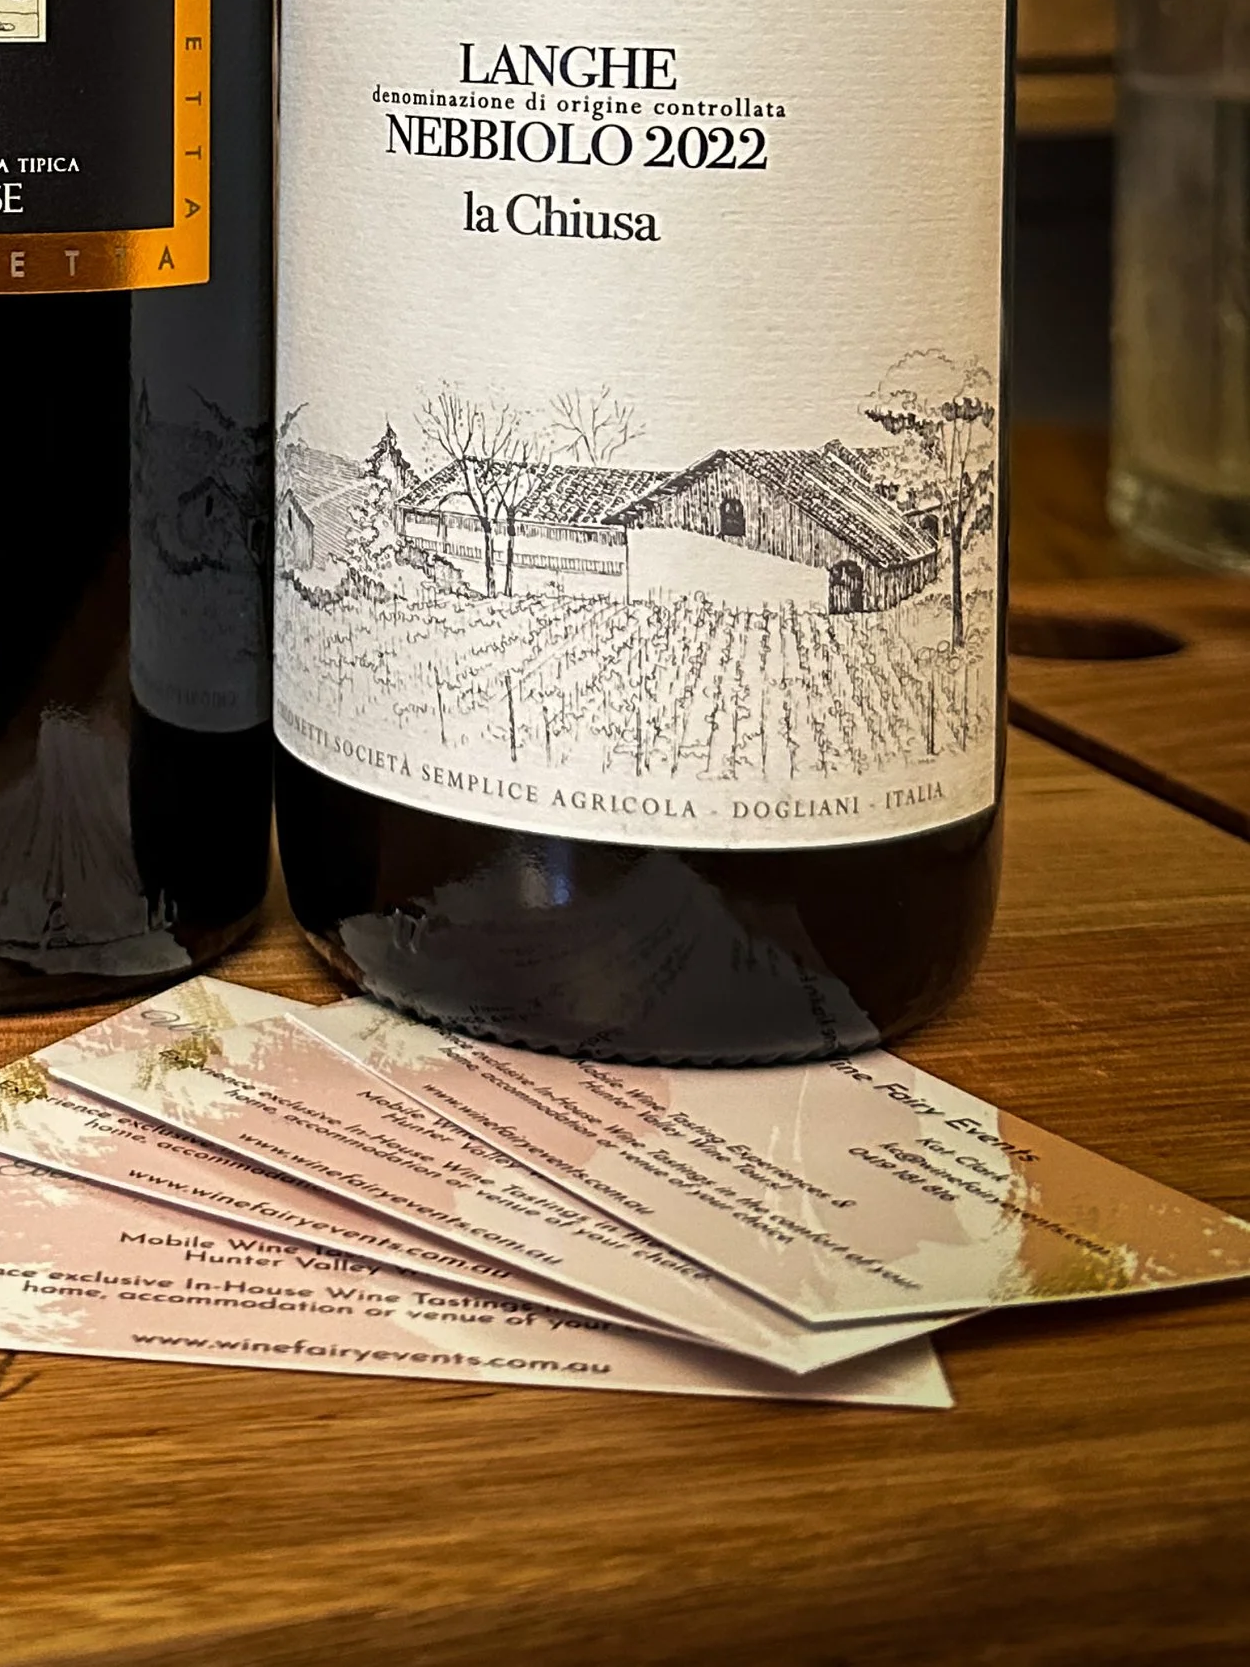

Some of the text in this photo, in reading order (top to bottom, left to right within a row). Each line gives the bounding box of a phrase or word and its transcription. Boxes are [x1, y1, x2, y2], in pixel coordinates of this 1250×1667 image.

[458, 42, 679, 92] LANGHE
[371, 85, 787, 121] denominazione di origine controllata
[17, 156, 80, 174] TIPICA
[385, 113, 770, 170] NEBBIOLO 2022
[463, 191, 661, 242] la Chiusa
[422, 763, 540, 804] SEMPLICE
[552, 793, 697, 819] AGRICOLA
[732, 797, 860, 820] DOGLIANI
[885, 780, 945, 810] ITALIA
[356, 1089, 426, 1121] Mobile
[381, 1111, 455, 1145] Hunter
[578, 1079, 636, 1111] Hunter
[636, 1109, 687, 1138] Valley
[688, 1136, 732, 1163] Wine
[828, 1055, 1041, 1164] ine Fairy Events
[83, 1117, 324, 1194] home, accommodat
[258, 1088, 343, 1126] exclusive
[344, 1123, 436, 1164] In-House
[442, 1160, 496, 1187] Wine
[499, 1183, 592, 1224] Tastings
[604, 1124, 647, 1149] Wine
[626, 1087, 667, 1112] Wine
[668, 1111, 727, 1146] Tasting
[726, 1143, 831, 1200] Experiences
[914, 1137, 1010, 1184] Kat Clark
[283, 1112, 443, 1180] accommodation
[445, 1176, 470, 1191] or
[476, 1188, 543, 1218] venue
[119, 1230, 216, 1251] Mobile
[227, 1238, 300, 1257] Wine
[184, 1248, 382, 1277] Hunter Valley
[48, 1270, 175, 1290] exclusive
[184, 1277, 316, 1300] In-House
[325, 1285, 402, 1305] Wine
[411, 1291, 533, 1314] Tastings
[118, 1288, 354, 1316] accommodation
[364, 1304, 393, 1319] or
[405, 1309, 495, 1326] venue
[505, 1313, 539, 1328] of
